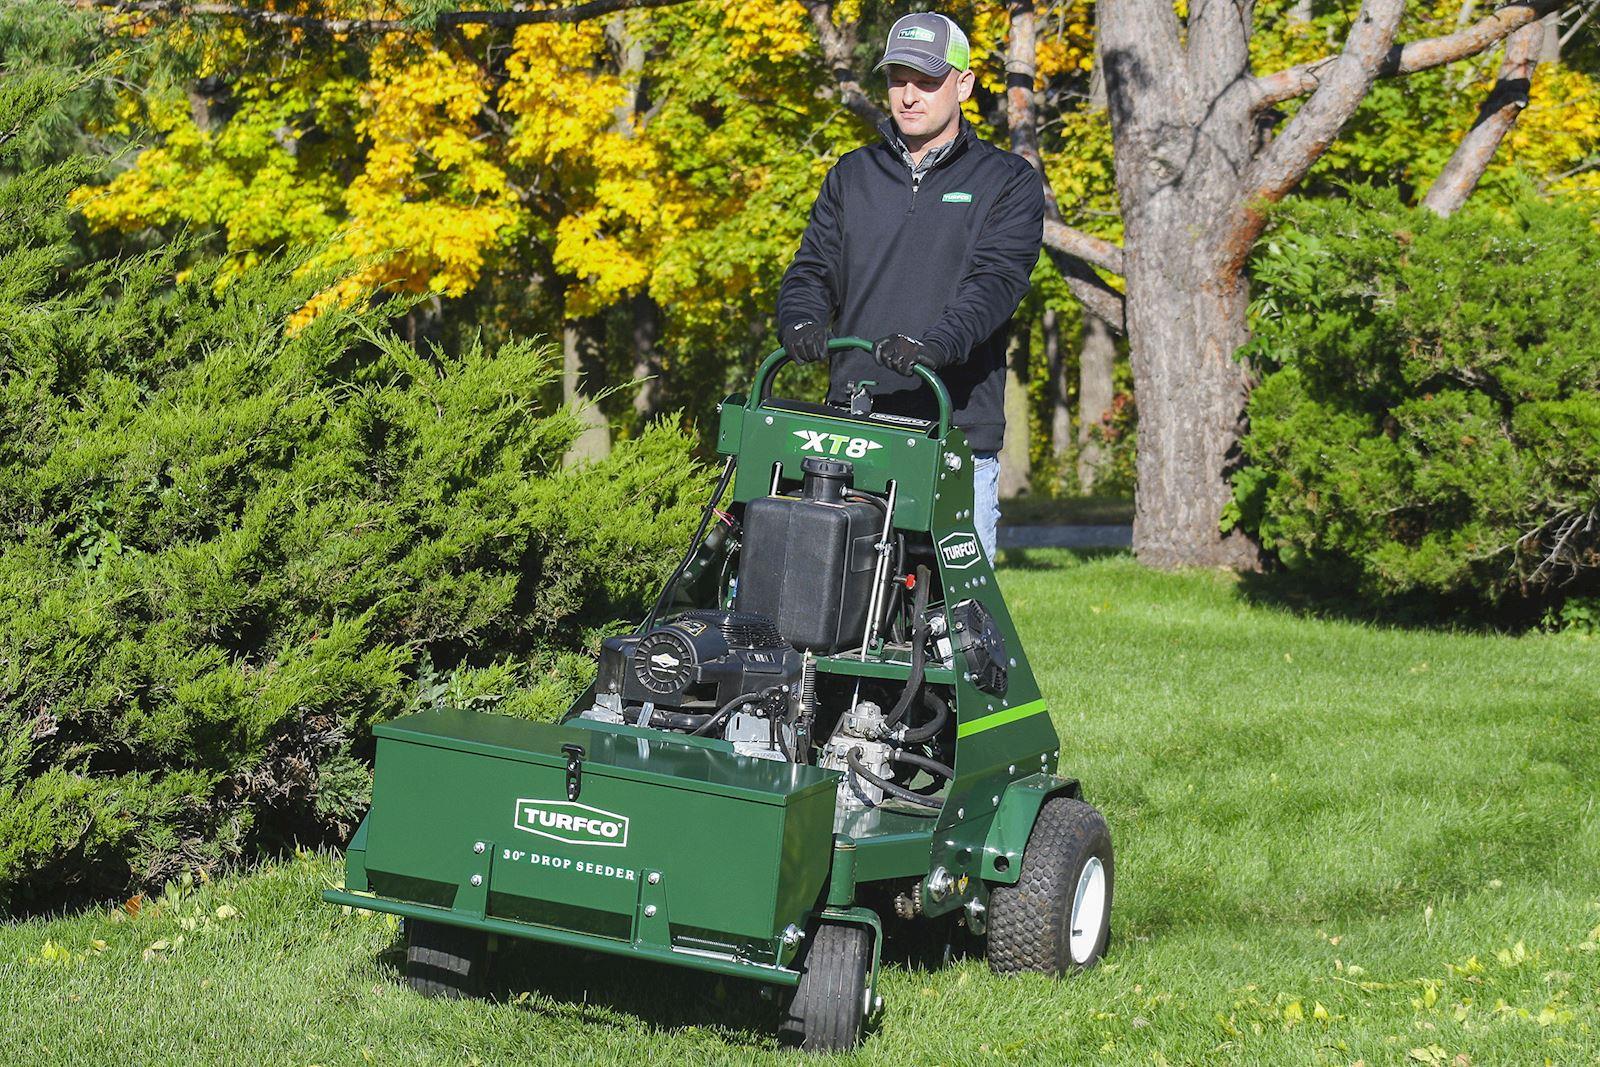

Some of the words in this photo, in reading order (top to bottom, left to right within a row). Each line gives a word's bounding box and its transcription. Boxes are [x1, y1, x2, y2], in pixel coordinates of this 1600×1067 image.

[800, 430, 869, 458] XT8
[943, 540, 976, 561] TURFCO
[524, 807, 619, 838] TURFCO
[531, 853, 572, 869] DROP
[575, 860, 635, 881] SEEDER
